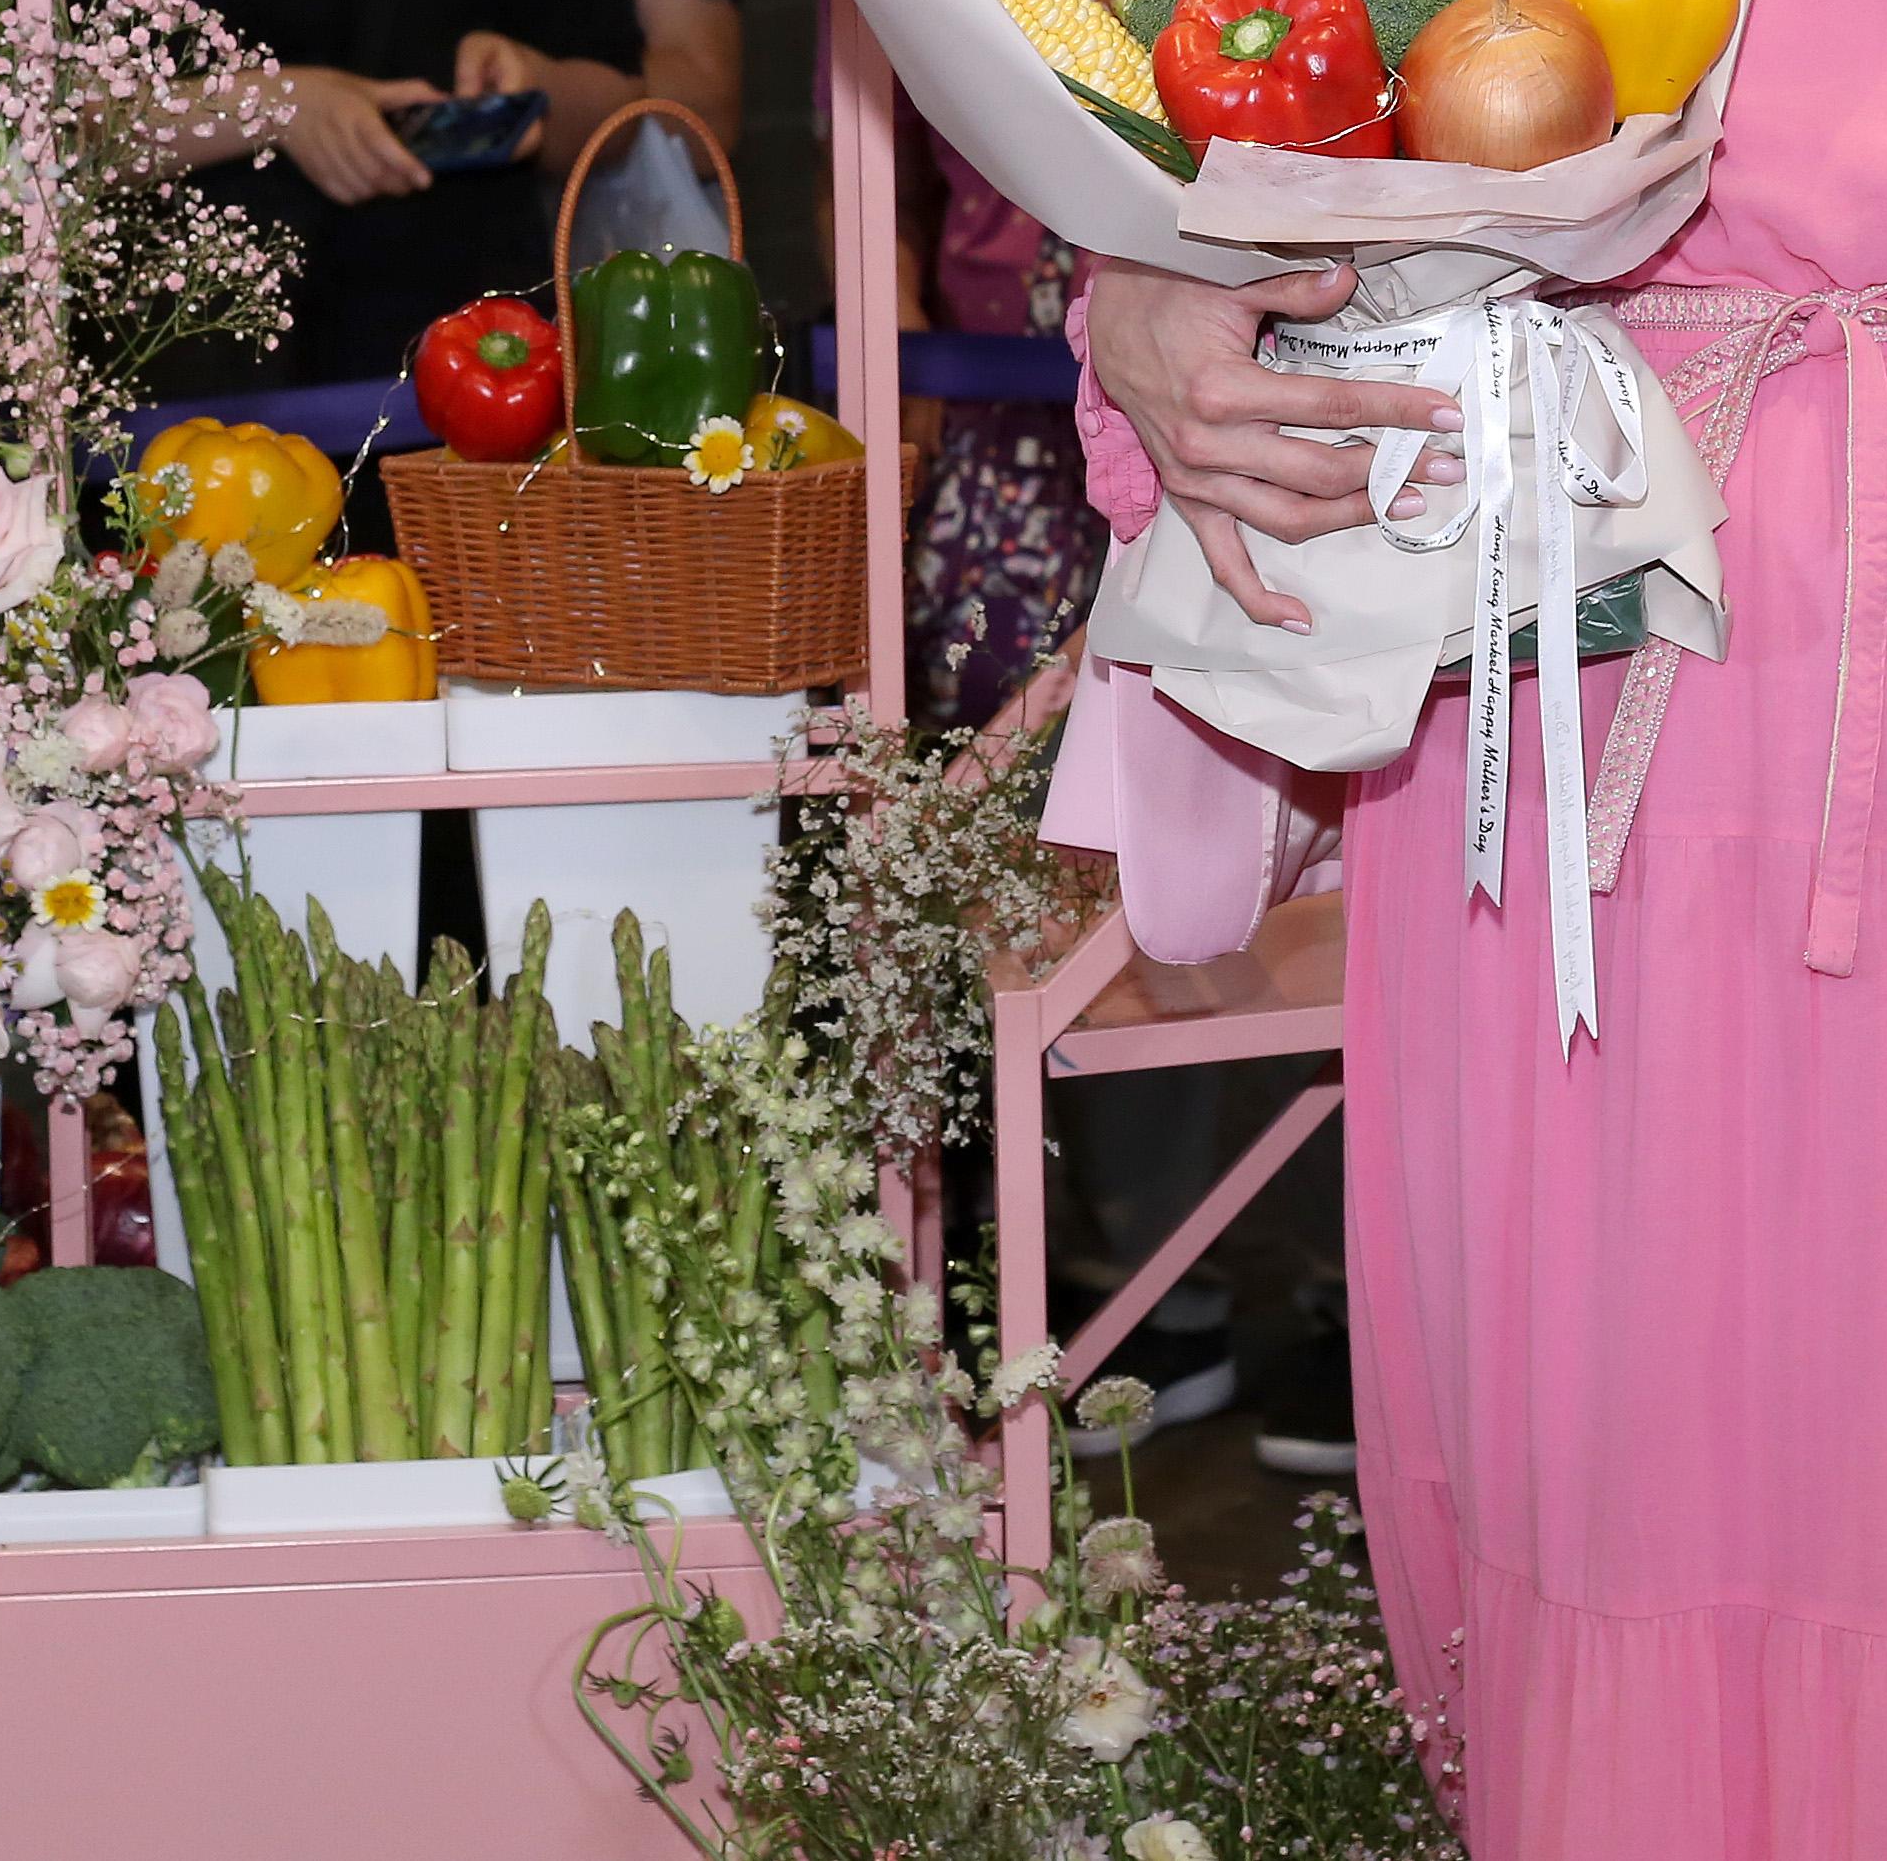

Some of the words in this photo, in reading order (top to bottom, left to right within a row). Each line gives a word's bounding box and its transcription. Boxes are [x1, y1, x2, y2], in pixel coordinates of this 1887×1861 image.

[1491, 359, 1505, 401] Day
[1489, 515, 1505, 562] Hong
[1486, 567, 1505, 608] Kong
[1488, 612, 1504, 676] Market
[1479, 677, 1502, 739] Happy
[1481, 743, 1500, 815] Mother's
[1473, 817, 1495, 854] Day
